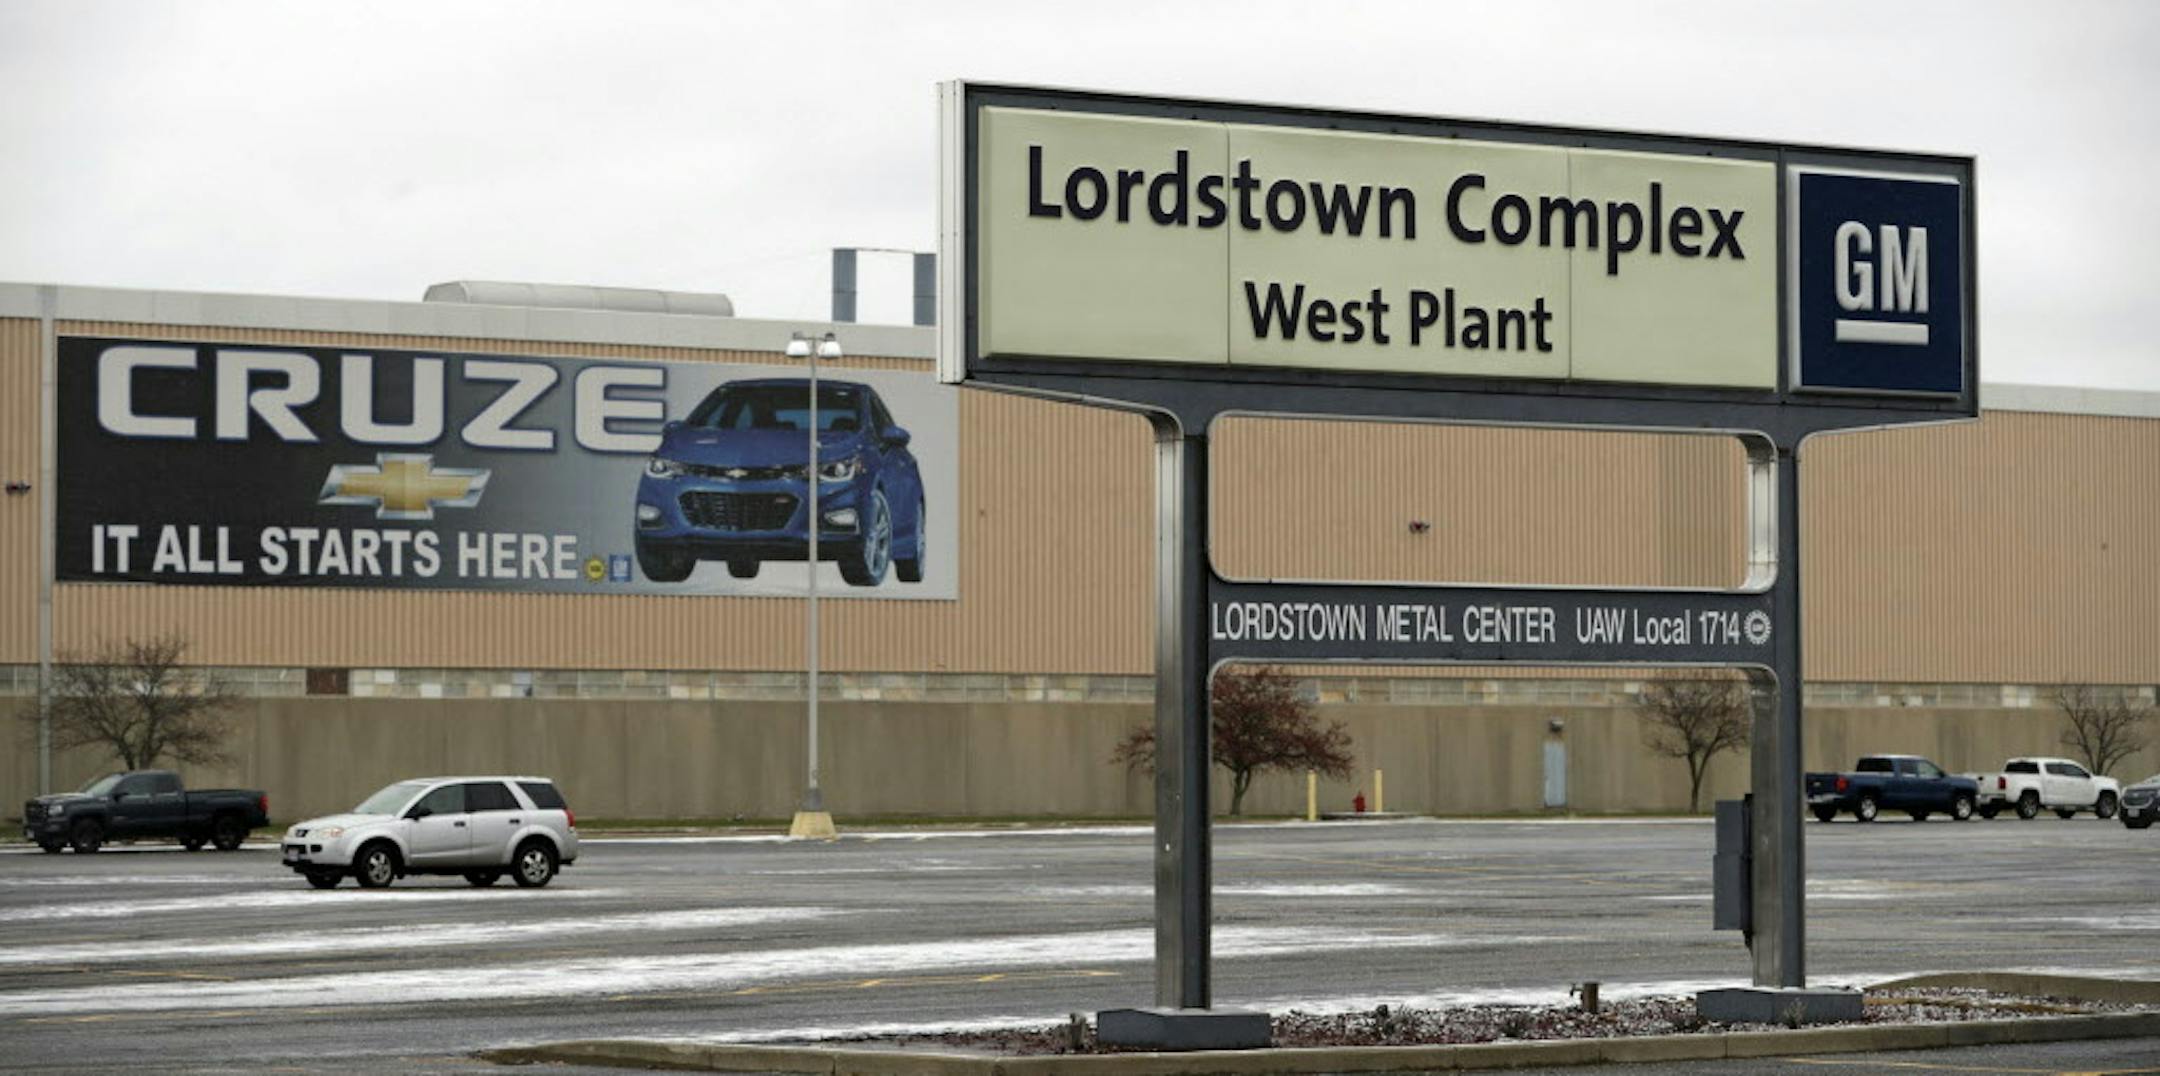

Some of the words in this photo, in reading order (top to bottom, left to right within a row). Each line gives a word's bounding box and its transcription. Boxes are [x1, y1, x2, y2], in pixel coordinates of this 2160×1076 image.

[1028, 145, 1417, 241] Lordstown
[1446, 173, 1746, 277] Complex
[1834, 220, 1930, 314] GM
[1244, 280, 1390, 345] West
[1410, 287, 1553, 353] Plant
[96, 345, 668, 454] CRUZE
[92, 524, 139, 574] IT
[152, 525, 244, 575] ALL
[259, 526, 442, 578] STARTS
[457, 532, 578, 580] HERE
[1212, 602, 1367, 641] LORDSTOWN
[1376, 604, 1454, 642] METAL
[1462, 606, 1556, 644] CENTER
[1576, 607, 1626, 645] UAW
[1633, 608, 1691, 645] Local
[1699, 610, 1741, 645] 1714
